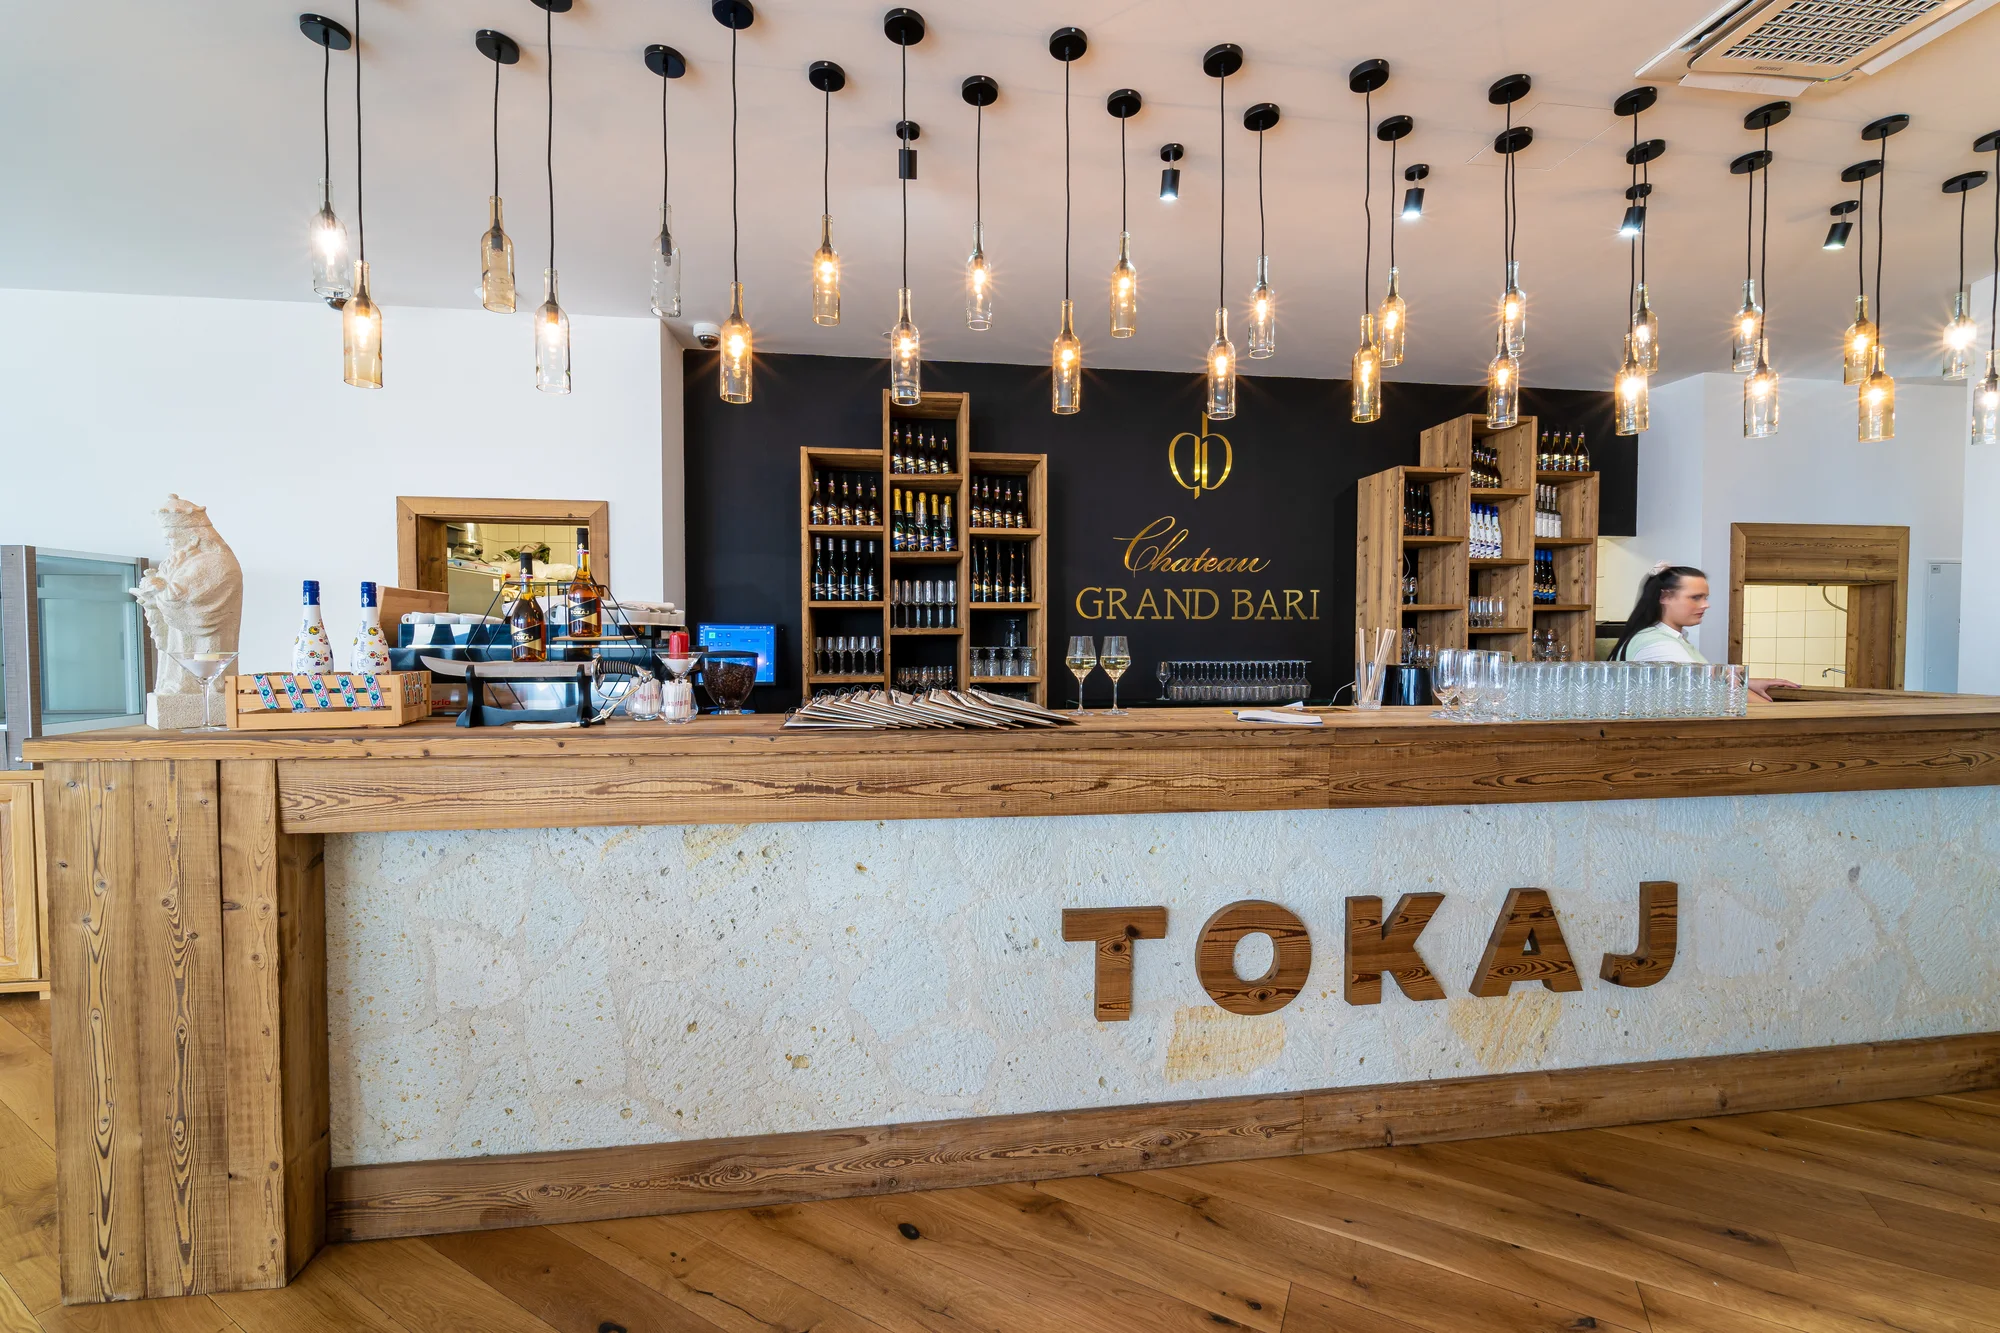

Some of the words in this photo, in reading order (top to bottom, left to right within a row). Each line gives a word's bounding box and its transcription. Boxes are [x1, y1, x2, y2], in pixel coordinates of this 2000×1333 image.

[1113, 516, 1271, 578] Chateau
[1075, 587, 1220, 620] GRAND
[1231, 589, 1320, 620] BARI
[1062, 881, 1678, 1021] TOKAJ
